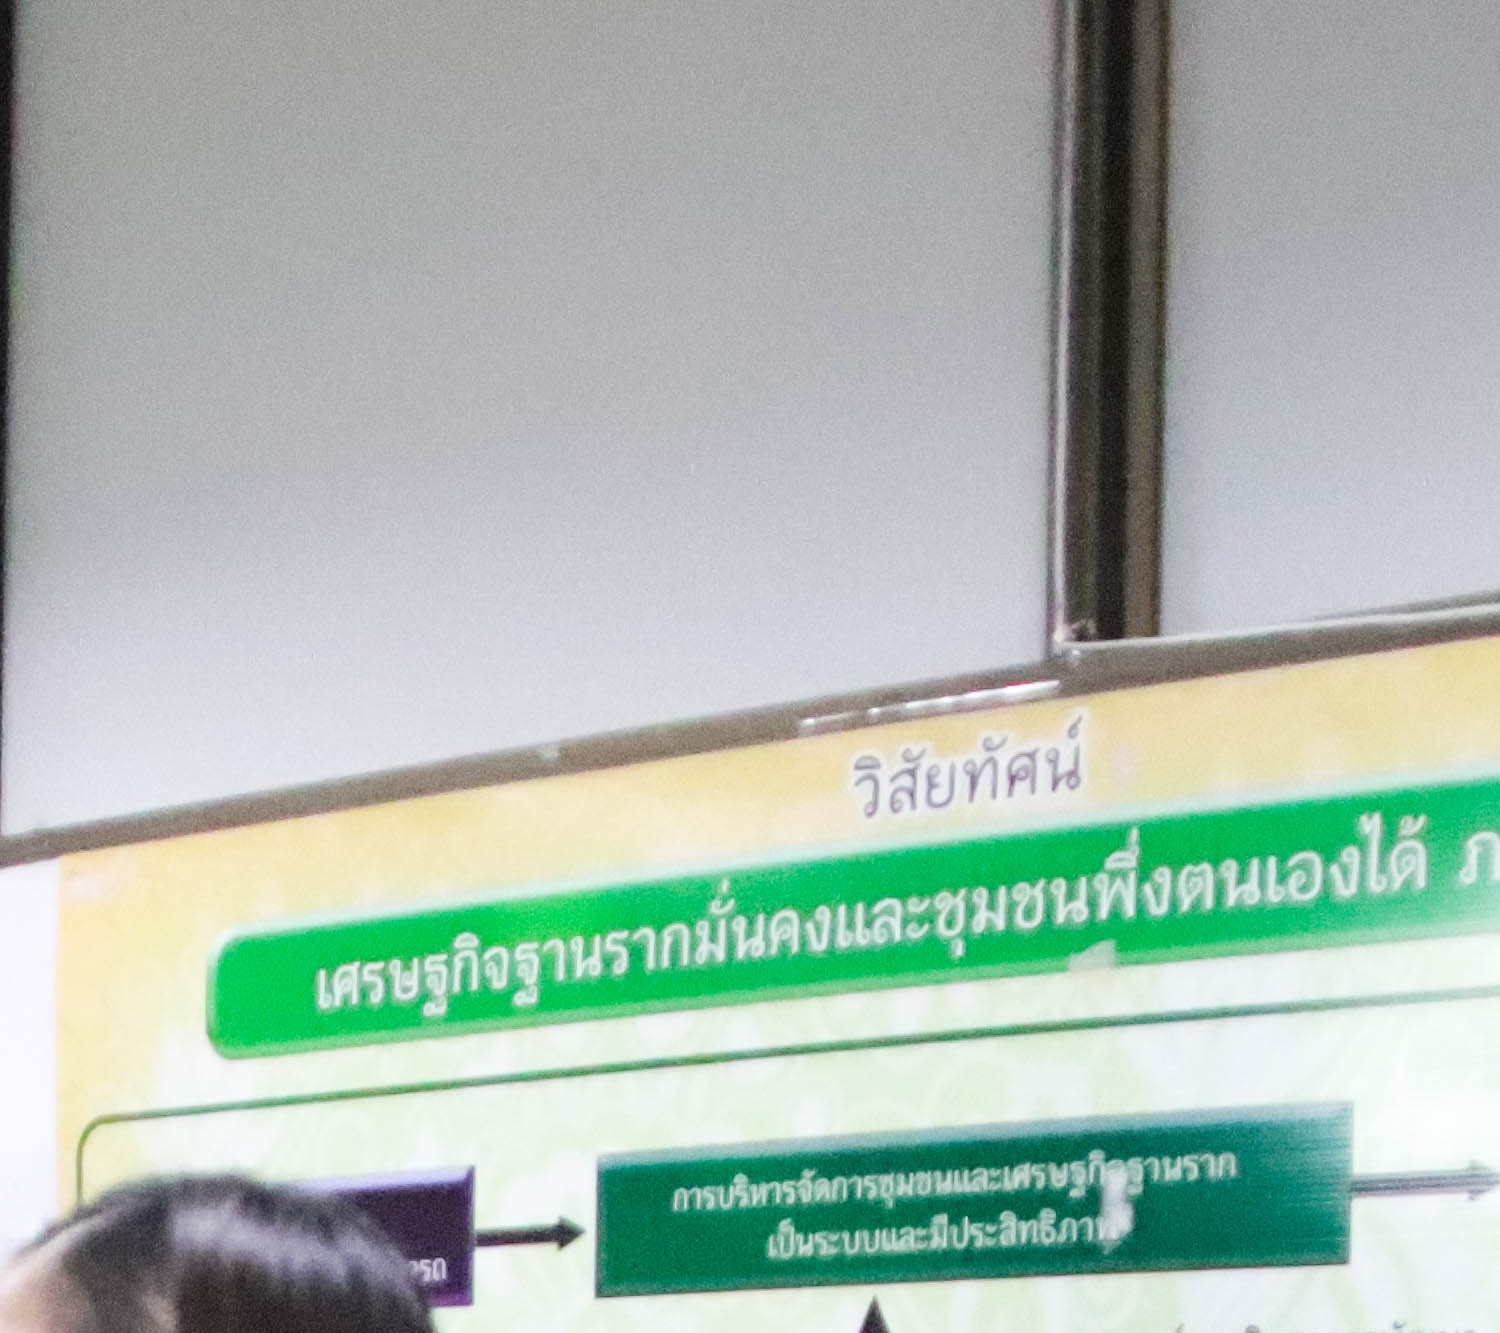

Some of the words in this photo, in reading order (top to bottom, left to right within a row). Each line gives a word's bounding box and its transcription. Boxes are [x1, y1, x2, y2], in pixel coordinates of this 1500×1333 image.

[851, 723, 1083, 820] วิสัยทัศน์
[315, 812, 1428, 1017] เศรษฐกิจฐานรากมั่นคงและชุมชนพึ่งตนเองได้
